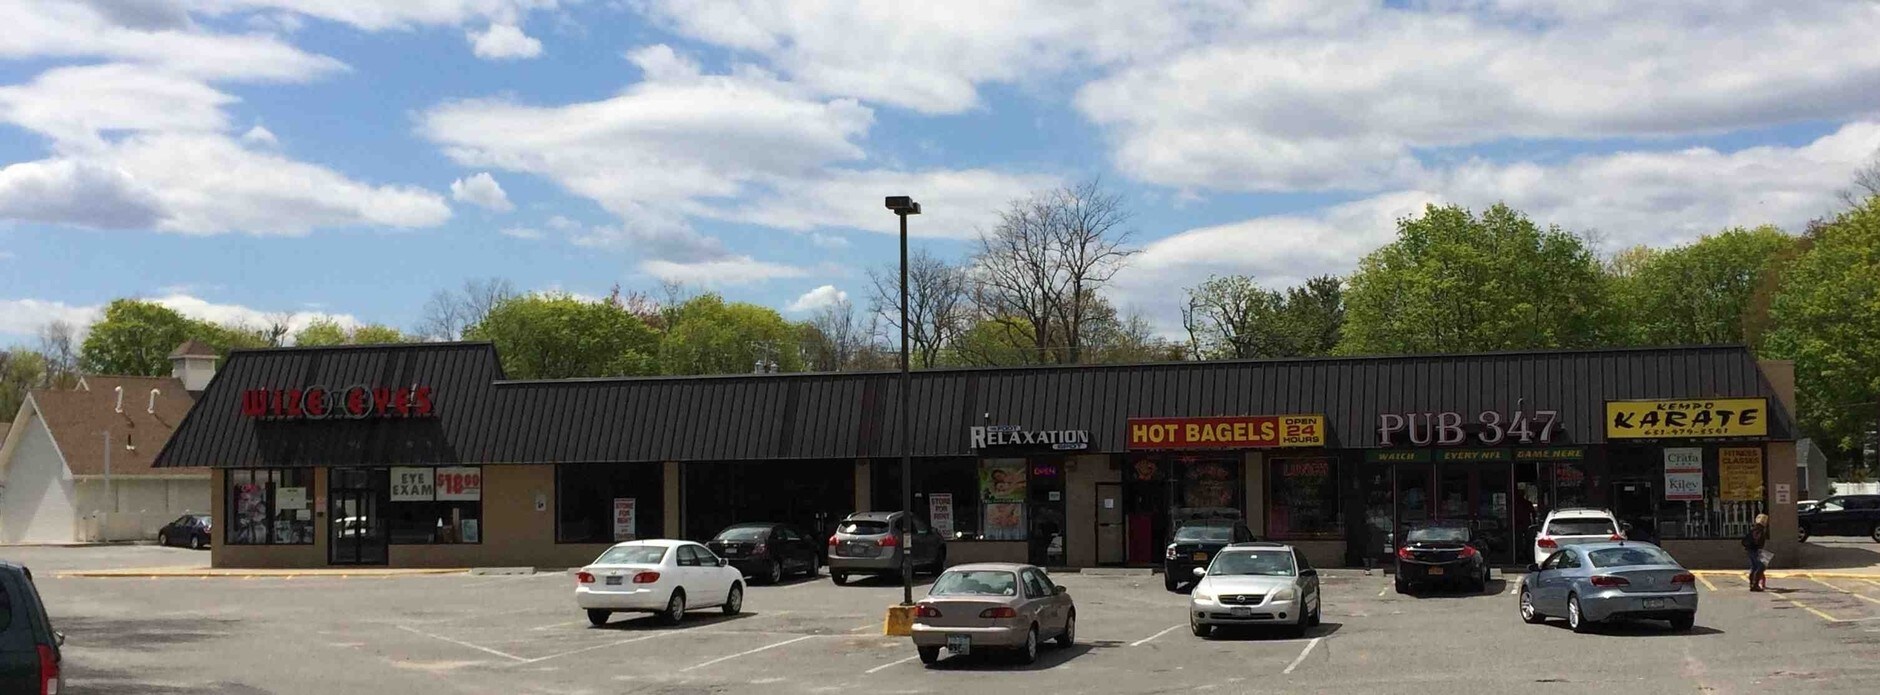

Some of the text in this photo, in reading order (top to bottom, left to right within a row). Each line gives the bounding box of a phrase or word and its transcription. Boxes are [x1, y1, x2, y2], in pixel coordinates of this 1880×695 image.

[1656, 402, 1715, 411] KEMPO
[1613, 409, 1759, 429] KARATE
[1132, 421, 1276, 443] HOT BAGELS
[1286, 425, 1316, 437] 24
[1376, 410, 1558, 447] PUB 347
[1282, 436, 1320, 444] HOURS
[1481, 450, 1502, 459] NFL
[1517, 449, 1550, 458] GAME
[401, 473, 425, 484] EYE
[392, 484, 433, 496] EXAM
